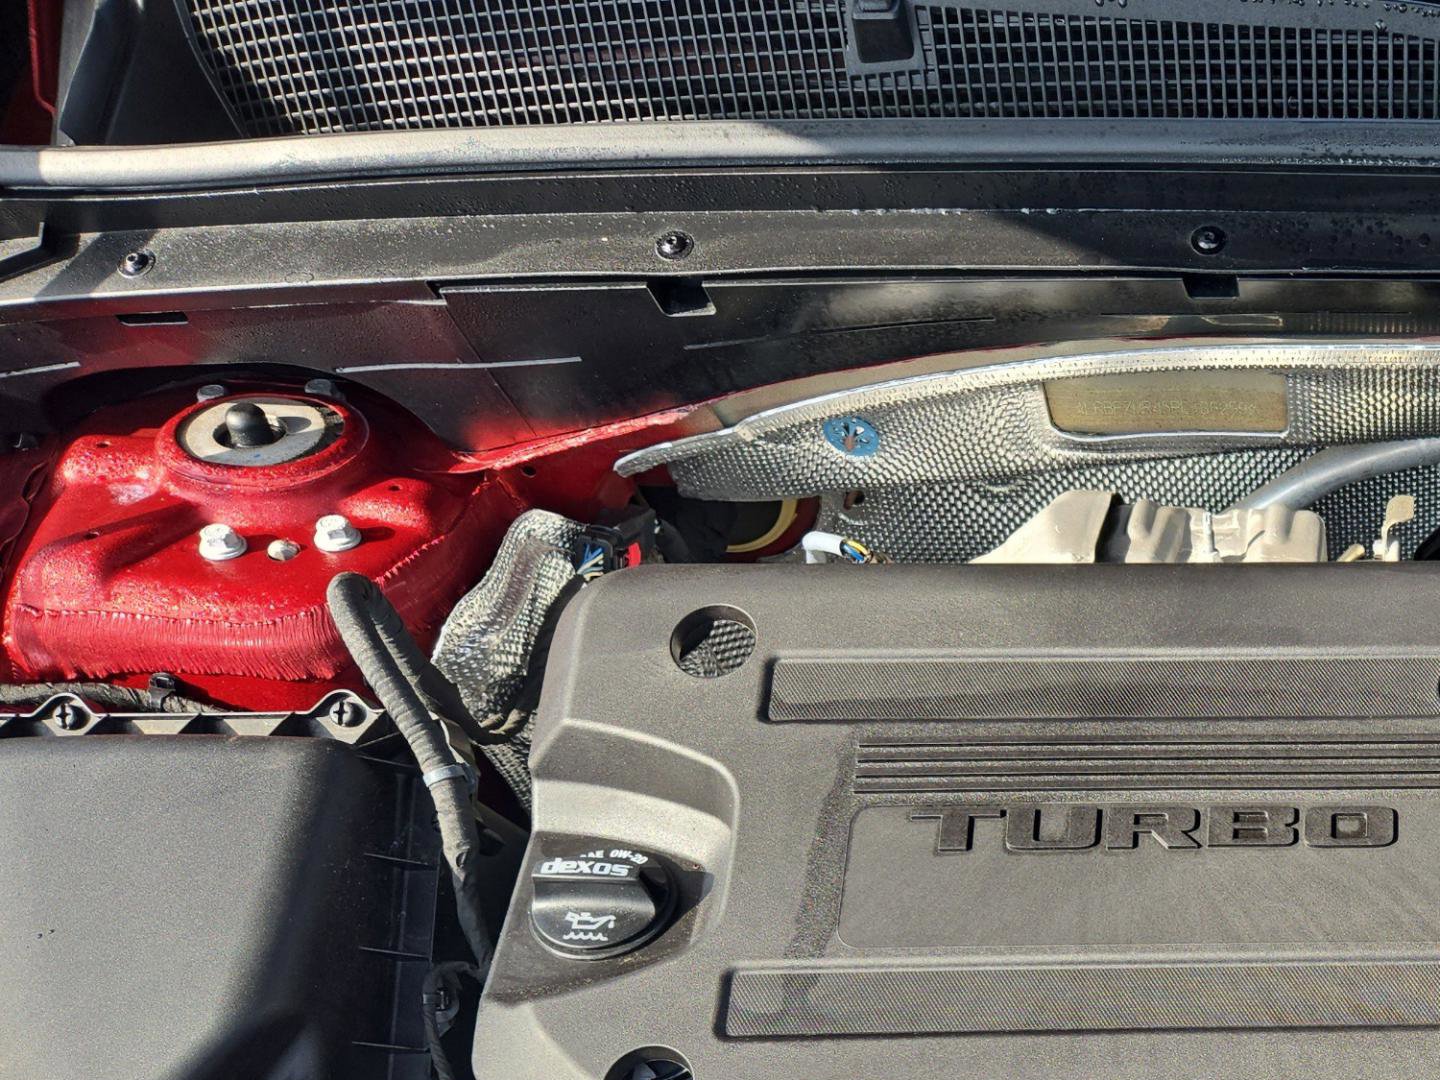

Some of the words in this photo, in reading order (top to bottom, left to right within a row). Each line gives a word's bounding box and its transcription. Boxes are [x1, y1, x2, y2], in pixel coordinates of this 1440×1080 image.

[910, 803, 1399, 852] TURBO
[540, 857, 634, 877] dexos
[609, 849, 649, 865] 0W-20
